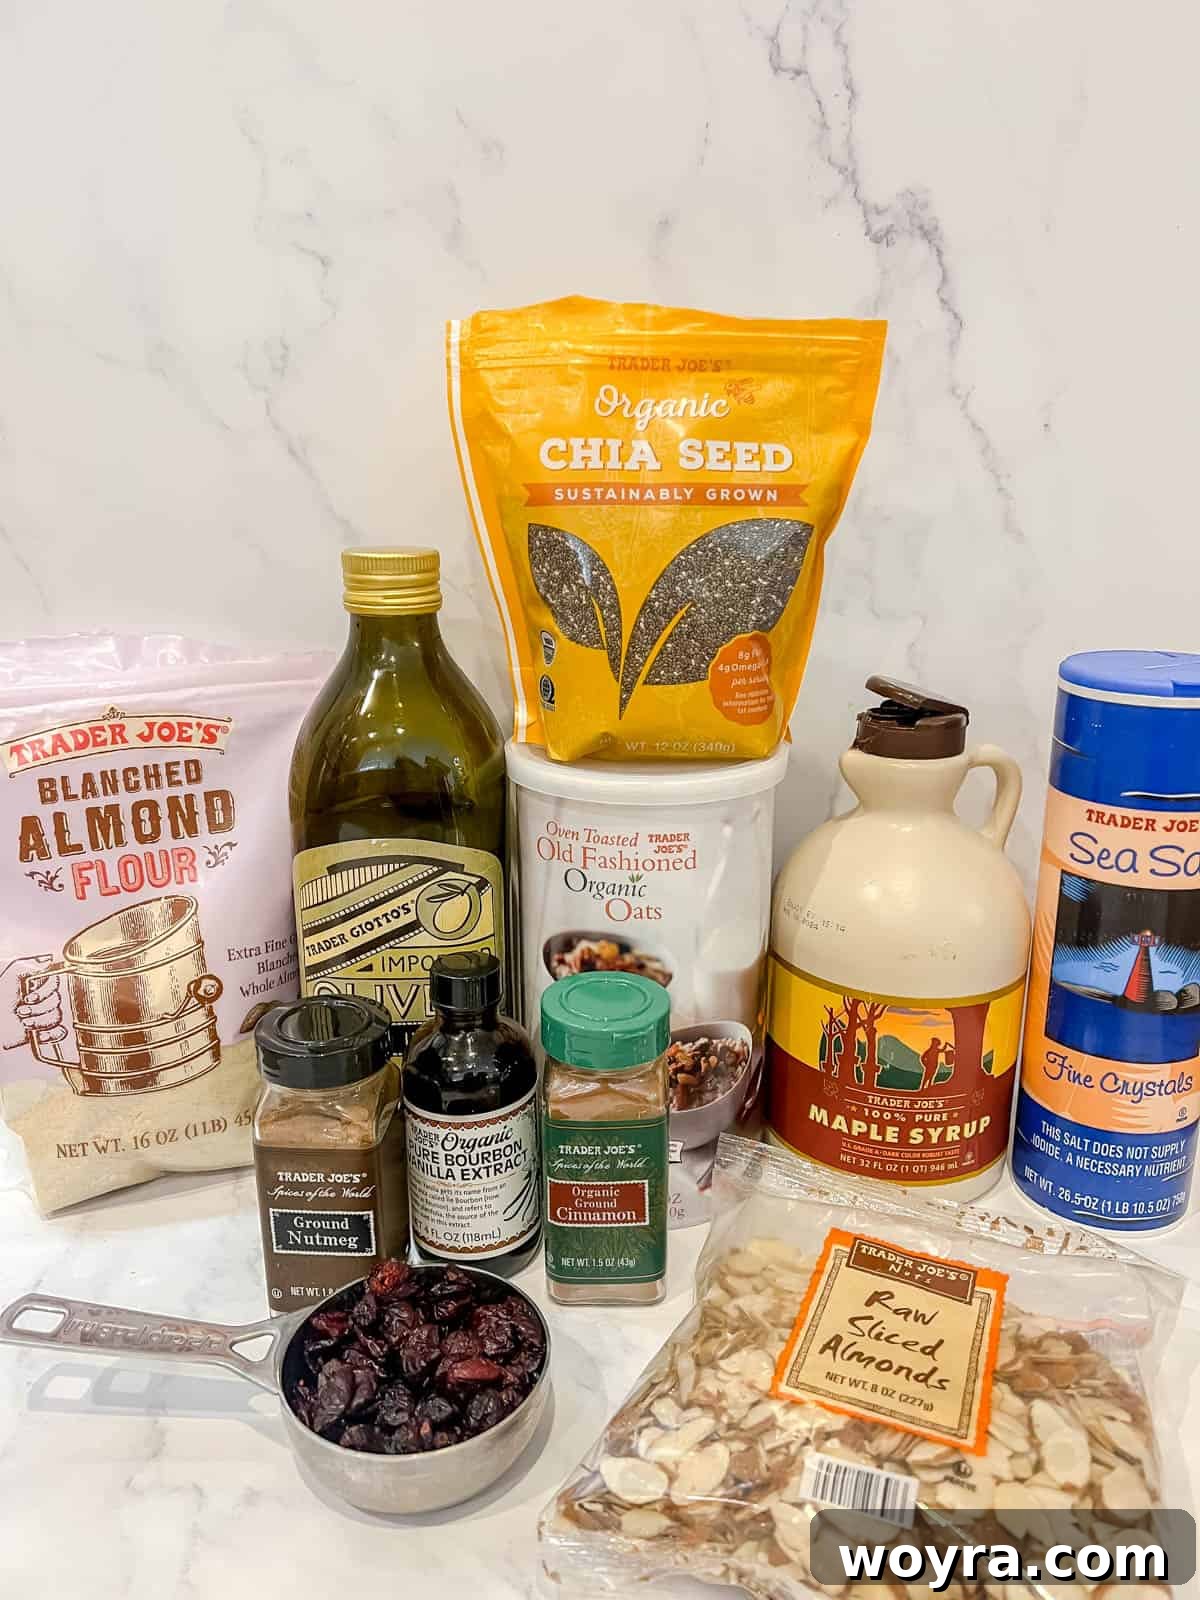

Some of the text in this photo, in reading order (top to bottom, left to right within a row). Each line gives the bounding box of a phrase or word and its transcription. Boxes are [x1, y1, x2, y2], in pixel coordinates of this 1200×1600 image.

[608, 357, 671, 373] TRADER
[594, 384, 731, 432] Organic
[539, 437, 793, 473] CHIA SEED
[554, 487, 778, 502] SUSTAINABLY GROWN
[9, 723, 129, 767] TRADER
[37, 758, 204, 806] BLANCHED
[19, 789, 236, 863] ALMOND
[1085, 808, 1157, 832] TRADER
[546, 820, 640, 848] Oven Toasted
[648, 832, 691, 844] TRADER
[536, 836, 697, 872] Old Fashioned
[1069, 831, 1139, 875] Sea
[71, 846, 199, 901] FLOUR
[564, 868, 648, 901] Organic
[605, 898, 663, 922] Oats
[306, 901, 412, 957] TRADER GIOTTO'S
[227, 946, 262, 961] Extra
[265, 938, 288, 954] Fine
[239, 977, 275, 998] Whole
[1042, 1050, 1193, 1104] Fine Crystals
[863, 1107, 948, 1122] 100% PURE
[867, 1095, 911, 1108] TRADER
[56, 1113, 254, 1159] NET WT. 16 OZ (1 LB) 45
[808, 1104, 991, 1145] MAPLE SYRUP
[408, 1138, 523, 1167] PURE BOURBON
[440, 1125, 514, 1154] Organic
[558, 1144, 602, 1155] TRADER
[1041, 1119, 1186, 1160] THIS SALT DOES NOT SUPPLY
[408, 1148, 529, 1181] VANILLA EXTRACT
[552, 1158, 585, 1172] Spices
[616, 1157, 651, 1169] World
[840, 1152, 856, 1164] NET
[859, 1157, 870, 1168] 32
[873, 1161, 882, 1171] FL
[885, 1163, 898, 1172] OZ
[1032, 1132, 1187, 1178] IODIDE. A NECESSARY NUTRIENT
[276, 1171, 325, 1183] TRADER
[1024, 1165, 1039, 1185] NET
[1039, 1176, 1056, 1197] WT.
[1115, 1199, 1129, 1214] LB
[1132, 1200, 1153, 1215] 10.5
[1155, 1197, 1171, 1214] OZ)
[267, 1185, 304, 1200] Spices
[341, 1184, 376, 1199] World
[571, 1186, 620, 1198] Organic
[574, 1198, 617, 1209] Ground
[669, 1192, 682, 1204] Z
[293, 1216, 350, 1230] Ground
[556, 1206, 637, 1221] Cinnamon
[287, 1230, 359, 1249] Nutmeg
[443, 1231, 460, 1242] OZ
[462, 1227, 501, 1244] (118mL)
[561, 1257, 576, 1267] NET
[592, 1257, 604, 1267] 1.5
[605, 1257, 616, 1267] OZ
[860, 1243, 913, 1269] TRADER
[888, 1262, 932, 1284] Nuts
[290, 1286, 305, 1297] NET
[864, 1290, 939, 1326] Raw
[847, 1315, 945, 1361] Sliced
[818, 1333, 951, 1391] Almonds
[825, 1371, 934, 1413] NET WT. 8 OZ (227g)
